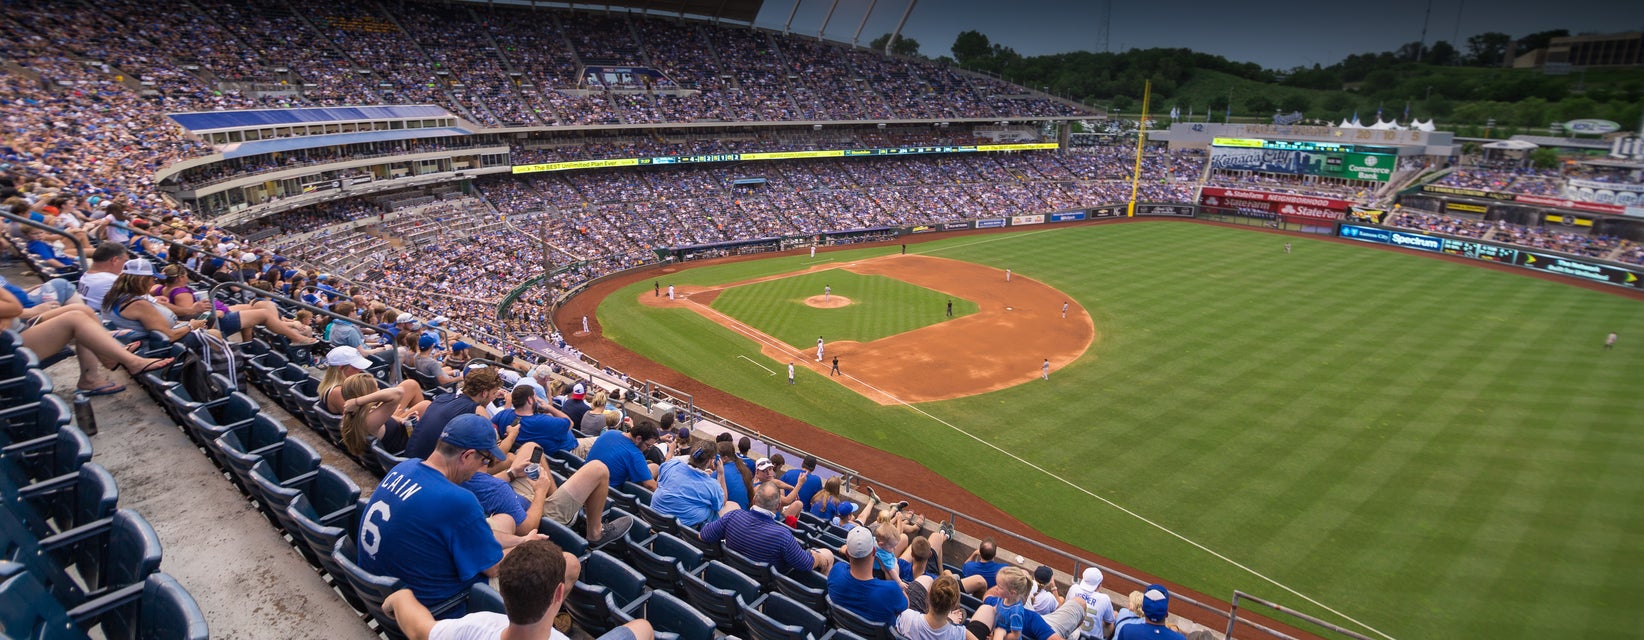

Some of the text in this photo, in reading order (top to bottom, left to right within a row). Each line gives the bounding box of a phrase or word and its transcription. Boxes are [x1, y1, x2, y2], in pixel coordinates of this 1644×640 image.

[1192, 123, 1203, 132] 42
[1356, 131, 1371, 139] 20
[1411, 132, 1419, 141] 5
[1212, 149, 1290, 168] Kansas City
[1348, 164, 1390, 174] Commerce
[1358, 172, 1378, 180] Bank
[1267, 194, 1329, 206] NEIGHBORHOOD
[1392, 233, 1438, 249] Spectrum
[381, 471, 422, 501] CAIN
[360, 500, 391, 556] 6
[1081, 607, 1097, 632] 5
